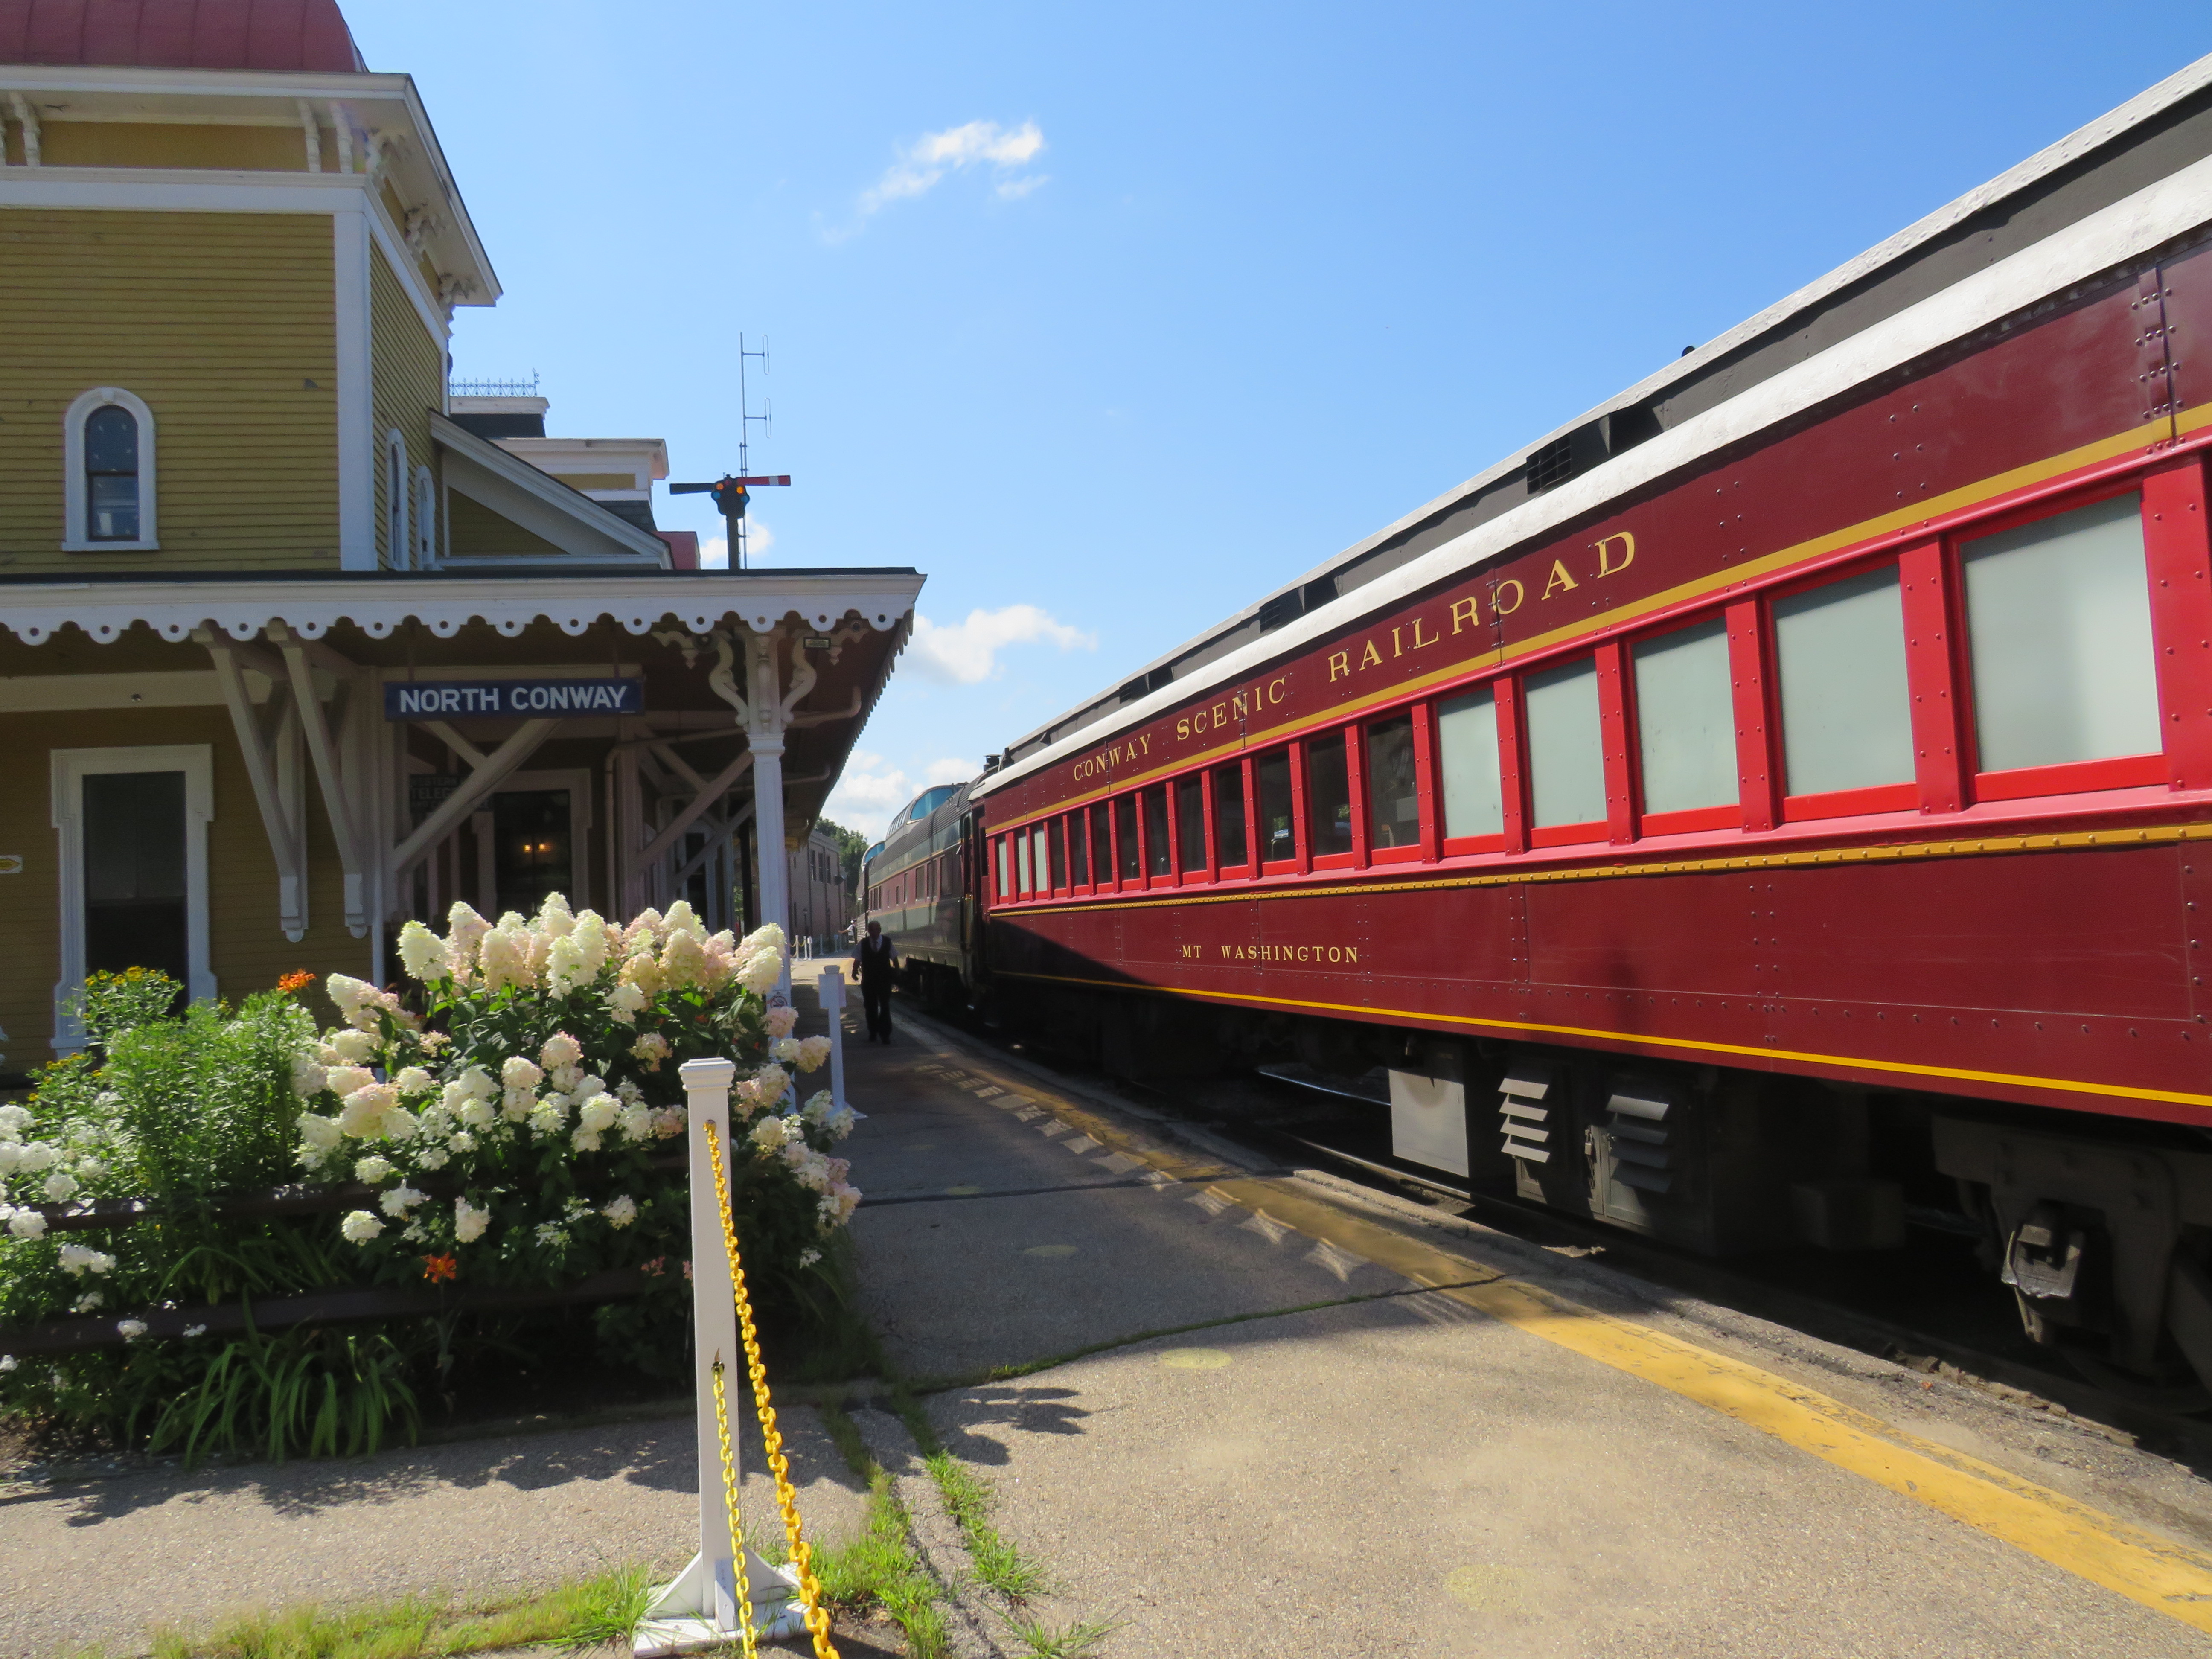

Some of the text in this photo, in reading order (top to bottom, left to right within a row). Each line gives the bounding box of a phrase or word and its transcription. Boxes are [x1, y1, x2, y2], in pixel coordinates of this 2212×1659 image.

[1074, 531, 1635, 781] CONWAY SCENIC RAILROAD
[400, 686, 627, 712] NORTH CONWAY
[1182, 945, 1358, 963] MT WASHINGTON
